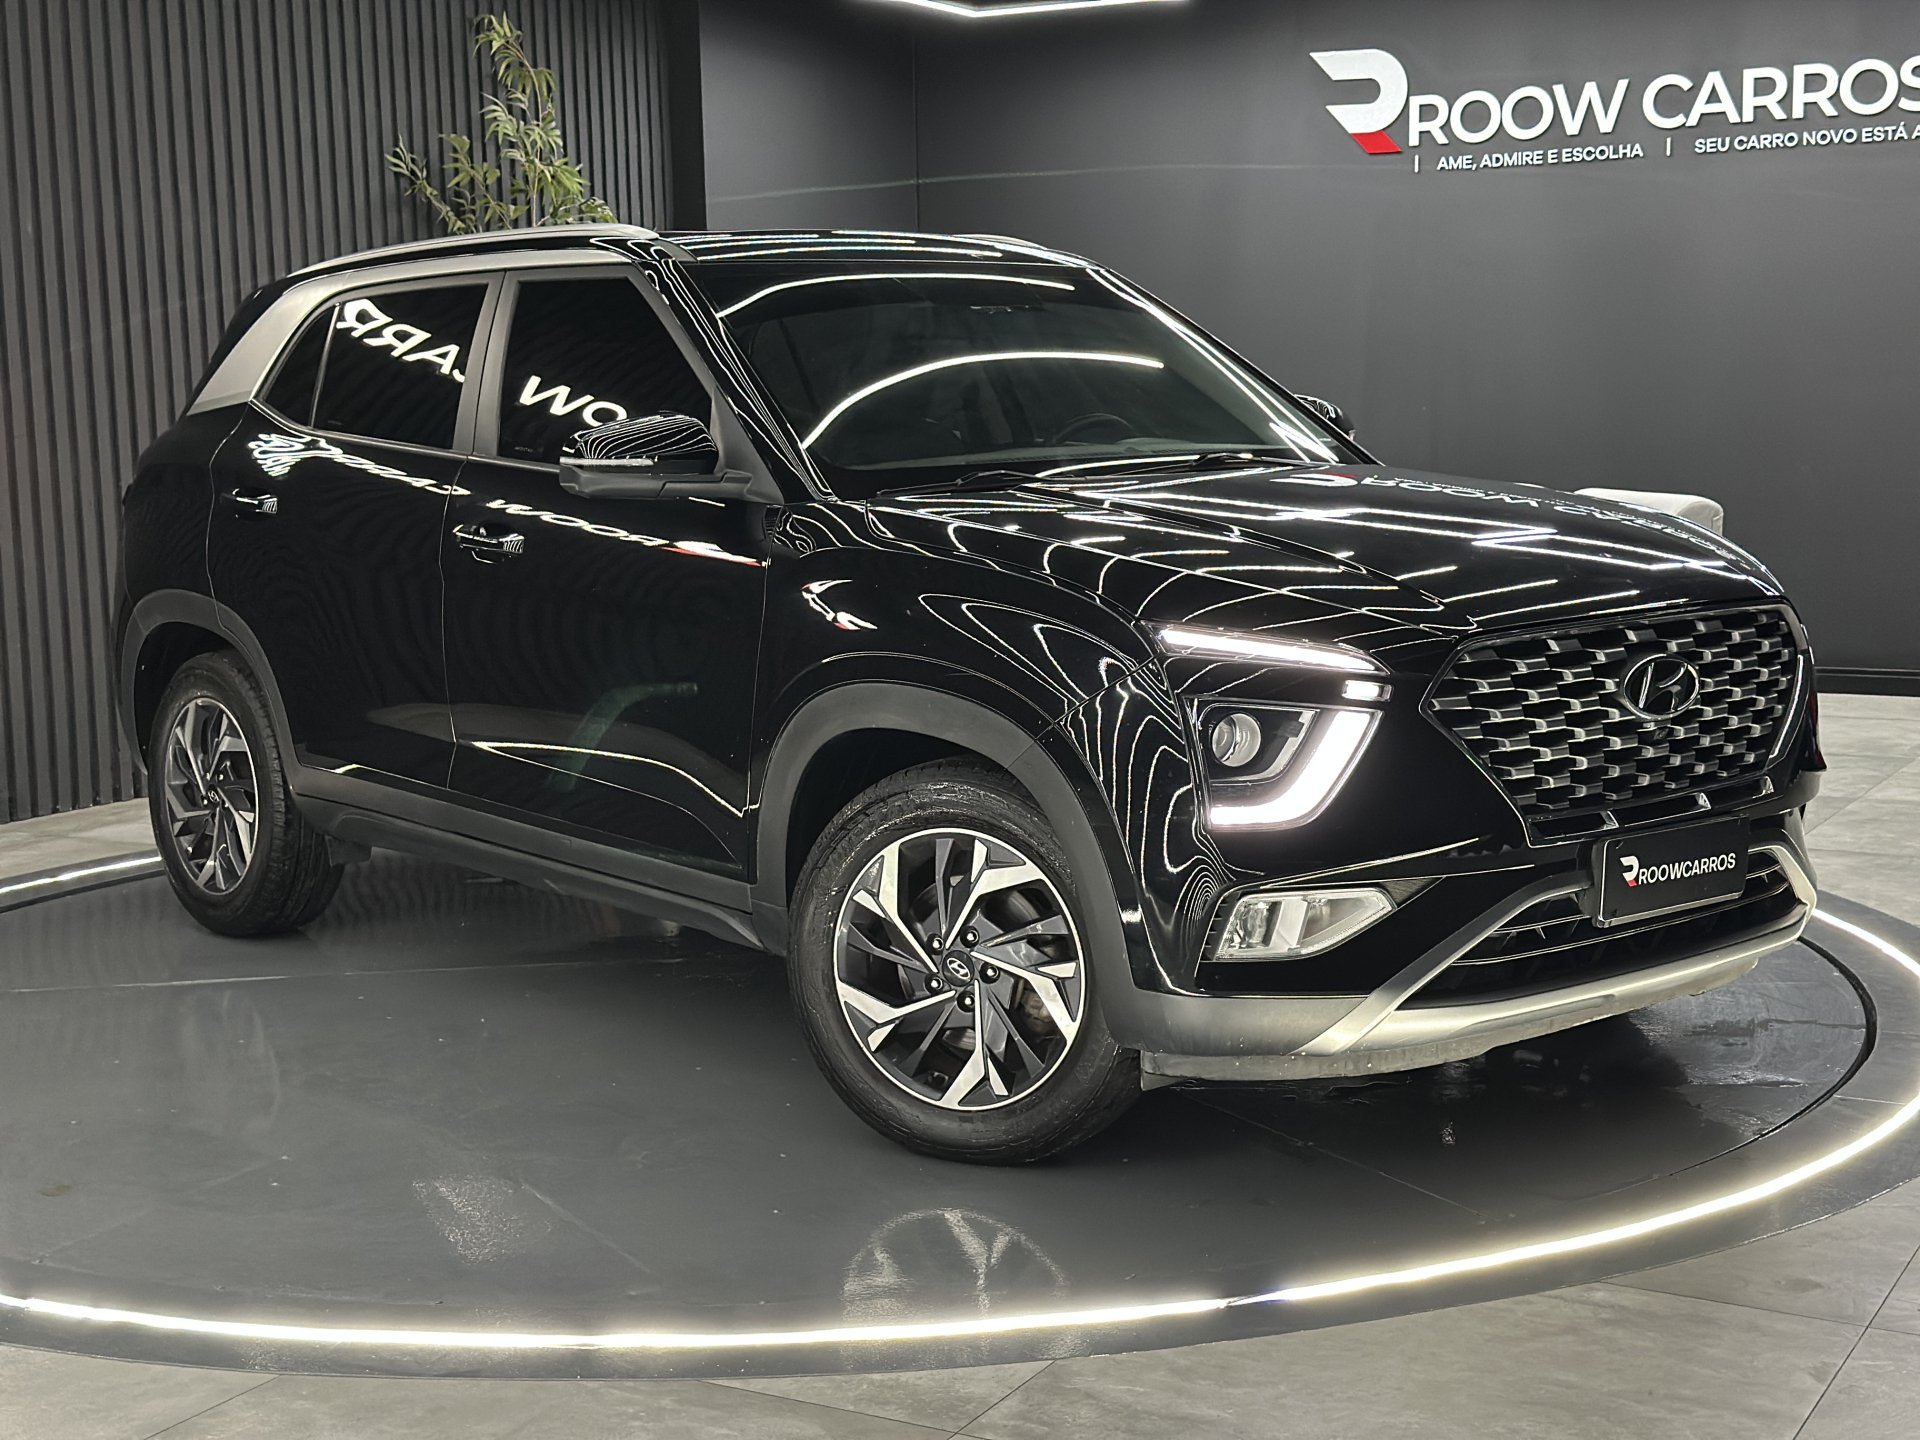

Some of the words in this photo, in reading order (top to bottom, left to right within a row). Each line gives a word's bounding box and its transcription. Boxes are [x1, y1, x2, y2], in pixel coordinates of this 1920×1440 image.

[1408, 78, 1630, 147] ROOW
[1437, 154, 1477, 171] AME,
[1480, 150, 1544, 168] ADMIRE
[1547, 148, 1559, 164] E
[1561, 142, 1644, 163] ESCOLHA
[1694, 136, 1731, 154] SEU
[1733, 131, 1799, 151] CARRO
[1802, 128, 1858, 146] NOVO
[1861, 121, 1909, 143] ESTÁ
[1638, 852, 1736, 885] ROOWCARROS
